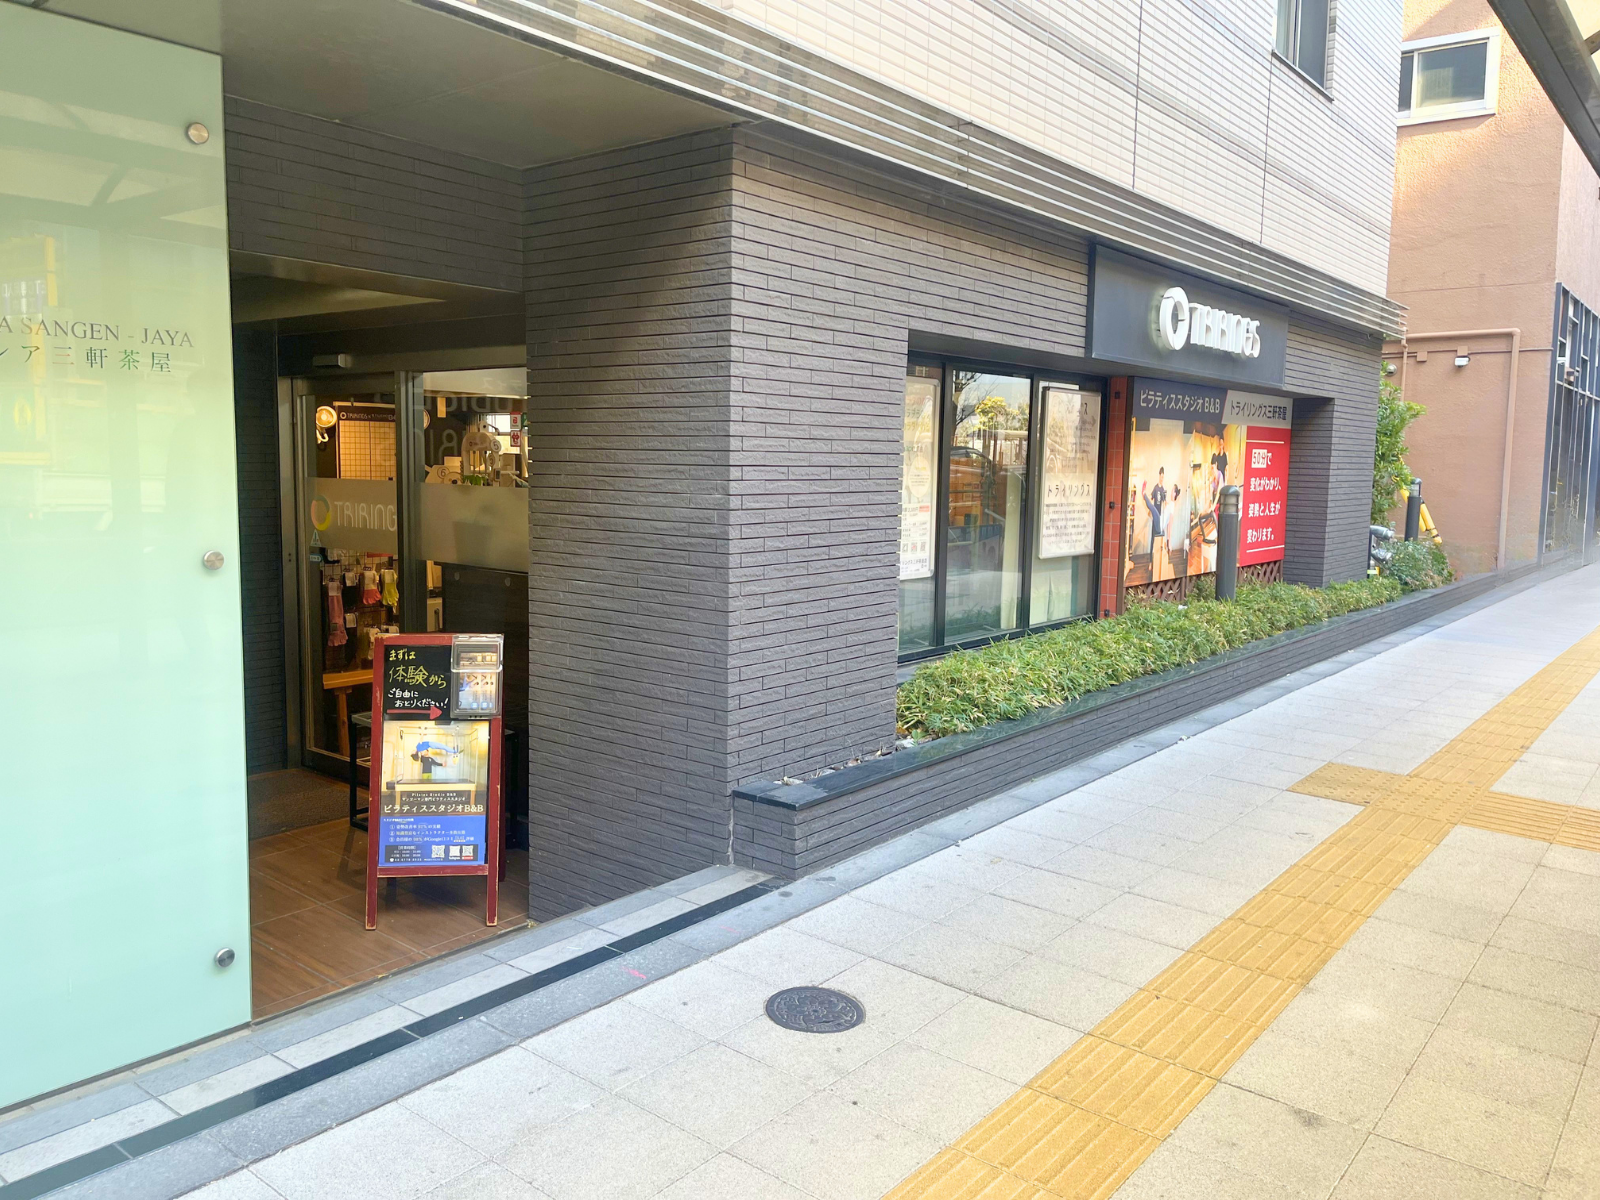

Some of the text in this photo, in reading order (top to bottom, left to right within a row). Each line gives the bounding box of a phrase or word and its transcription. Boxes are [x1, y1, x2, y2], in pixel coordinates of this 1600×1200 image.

[21, 317, 120, 342] SANGEN
[141, 327, 195, 348] JAYA
[1230, 400, 1288, 421] トライリングス三軒茶屋
[1252, 451, 1272, 466] 50分で
[1250, 477, 1281, 492] 変化がわかり、
[1248, 501, 1281, 518] 姿勢と人生が
[1247, 527, 1274, 544] 変わります。
[389, 648, 416, 661] まずは
[389, 664, 447, 689] 体験から
[388, 688, 419, 698] ご自由に
[384, 804, 484, 813] ピラティススタジオB&B
